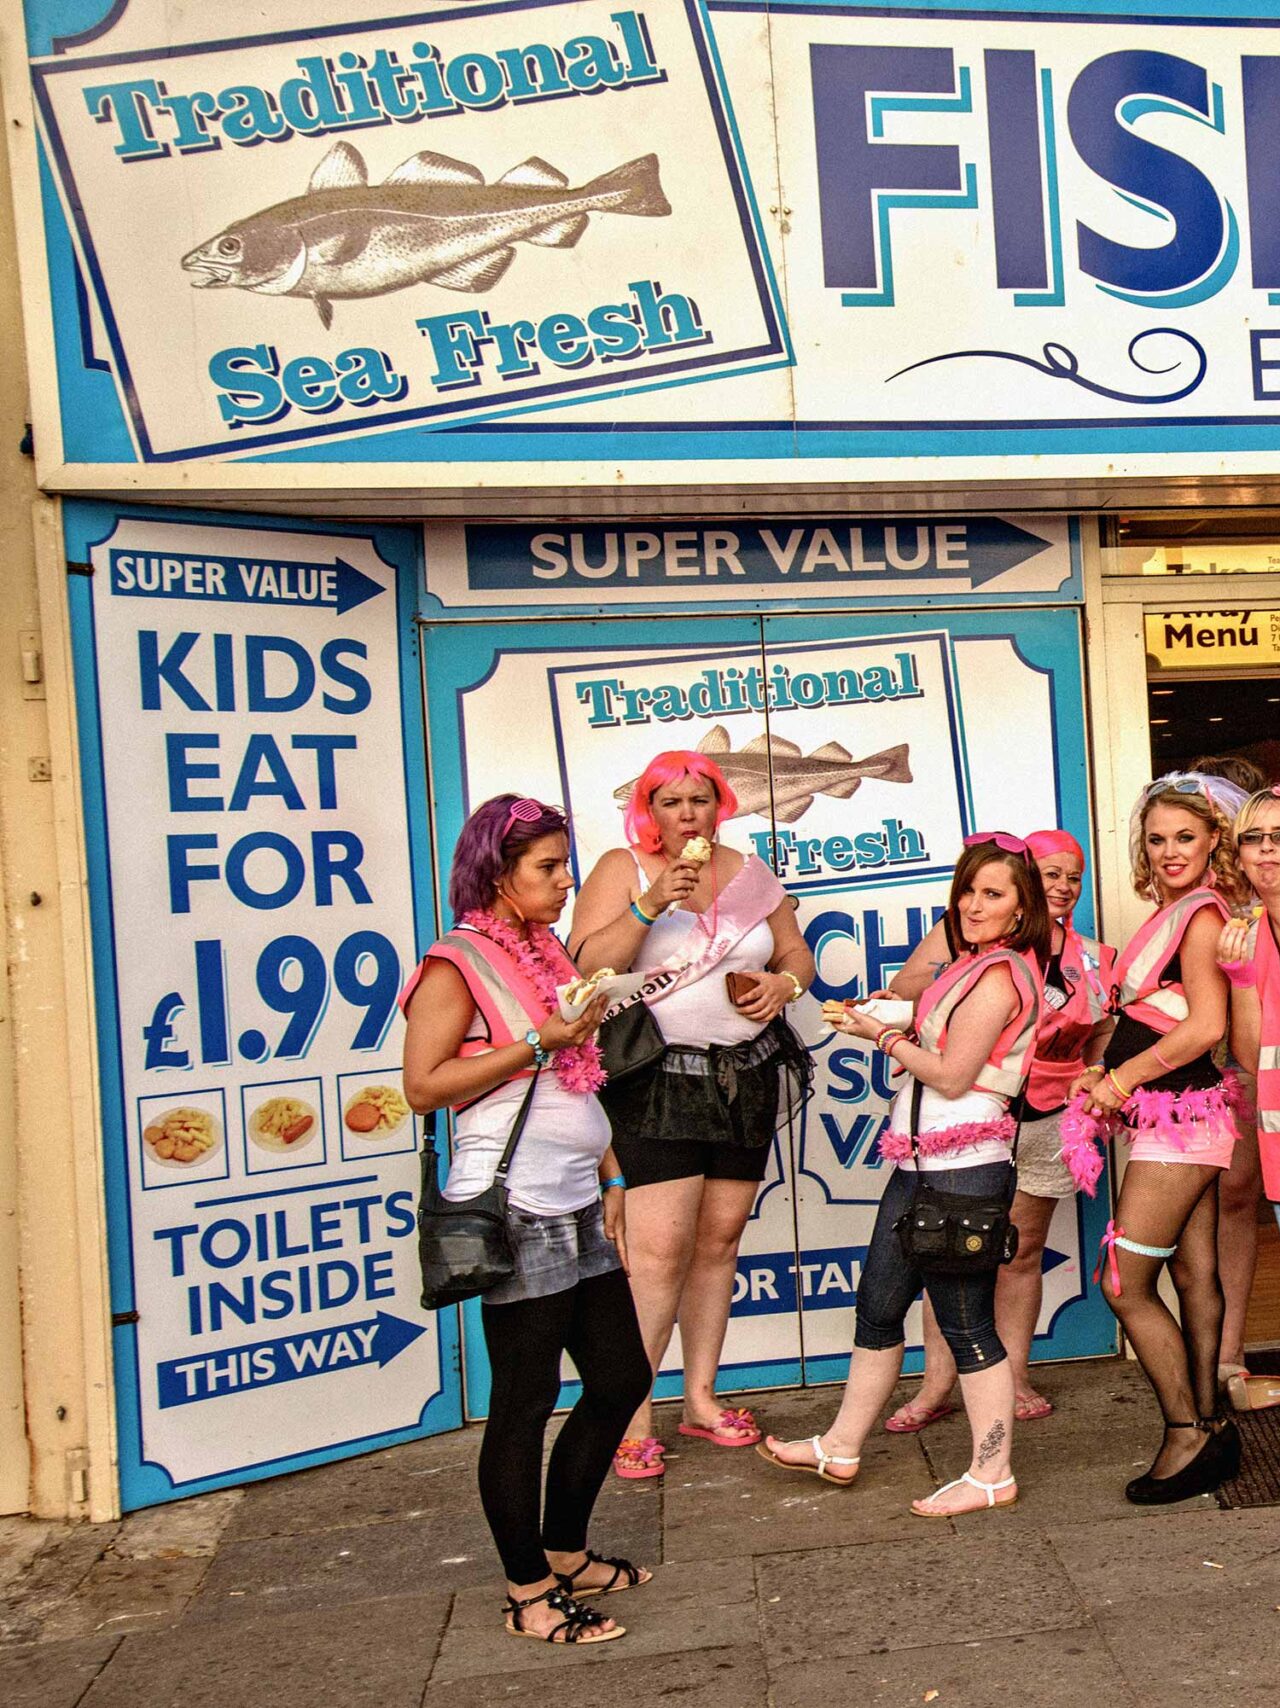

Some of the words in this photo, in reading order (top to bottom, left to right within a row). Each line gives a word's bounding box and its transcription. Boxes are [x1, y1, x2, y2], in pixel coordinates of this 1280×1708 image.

[85, 11, 669, 163] Traditional
[208, 344, 409, 428] Sea
[417, 280, 713, 392] Fresh
[116, 556, 227, 597] SUPER
[239, 564, 337, 602] VALUE
[529, 531, 746, 579] SUPER
[759, 525, 970, 575] VALUE
[1267, 556, 1280, 564] Tea
[138, 630, 372, 715] KIDS
[1165, 623, 1258, 649] Menu
[1271, 634, 1276, 642] 7
[575, 653, 924, 728] Traditional
[165, 733, 357, 813] EAT
[167, 831, 373, 914] FOR
[749, 819, 930, 877] Fresh
[142, 930, 405, 1072] £1.99
[154, 1190, 417, 1277] TOILETS
[191, 1251, 395, 1336] INSIDE
[176, 1346, 277, 1397] THIS
[290, 1325, 380, 1375] WAY
